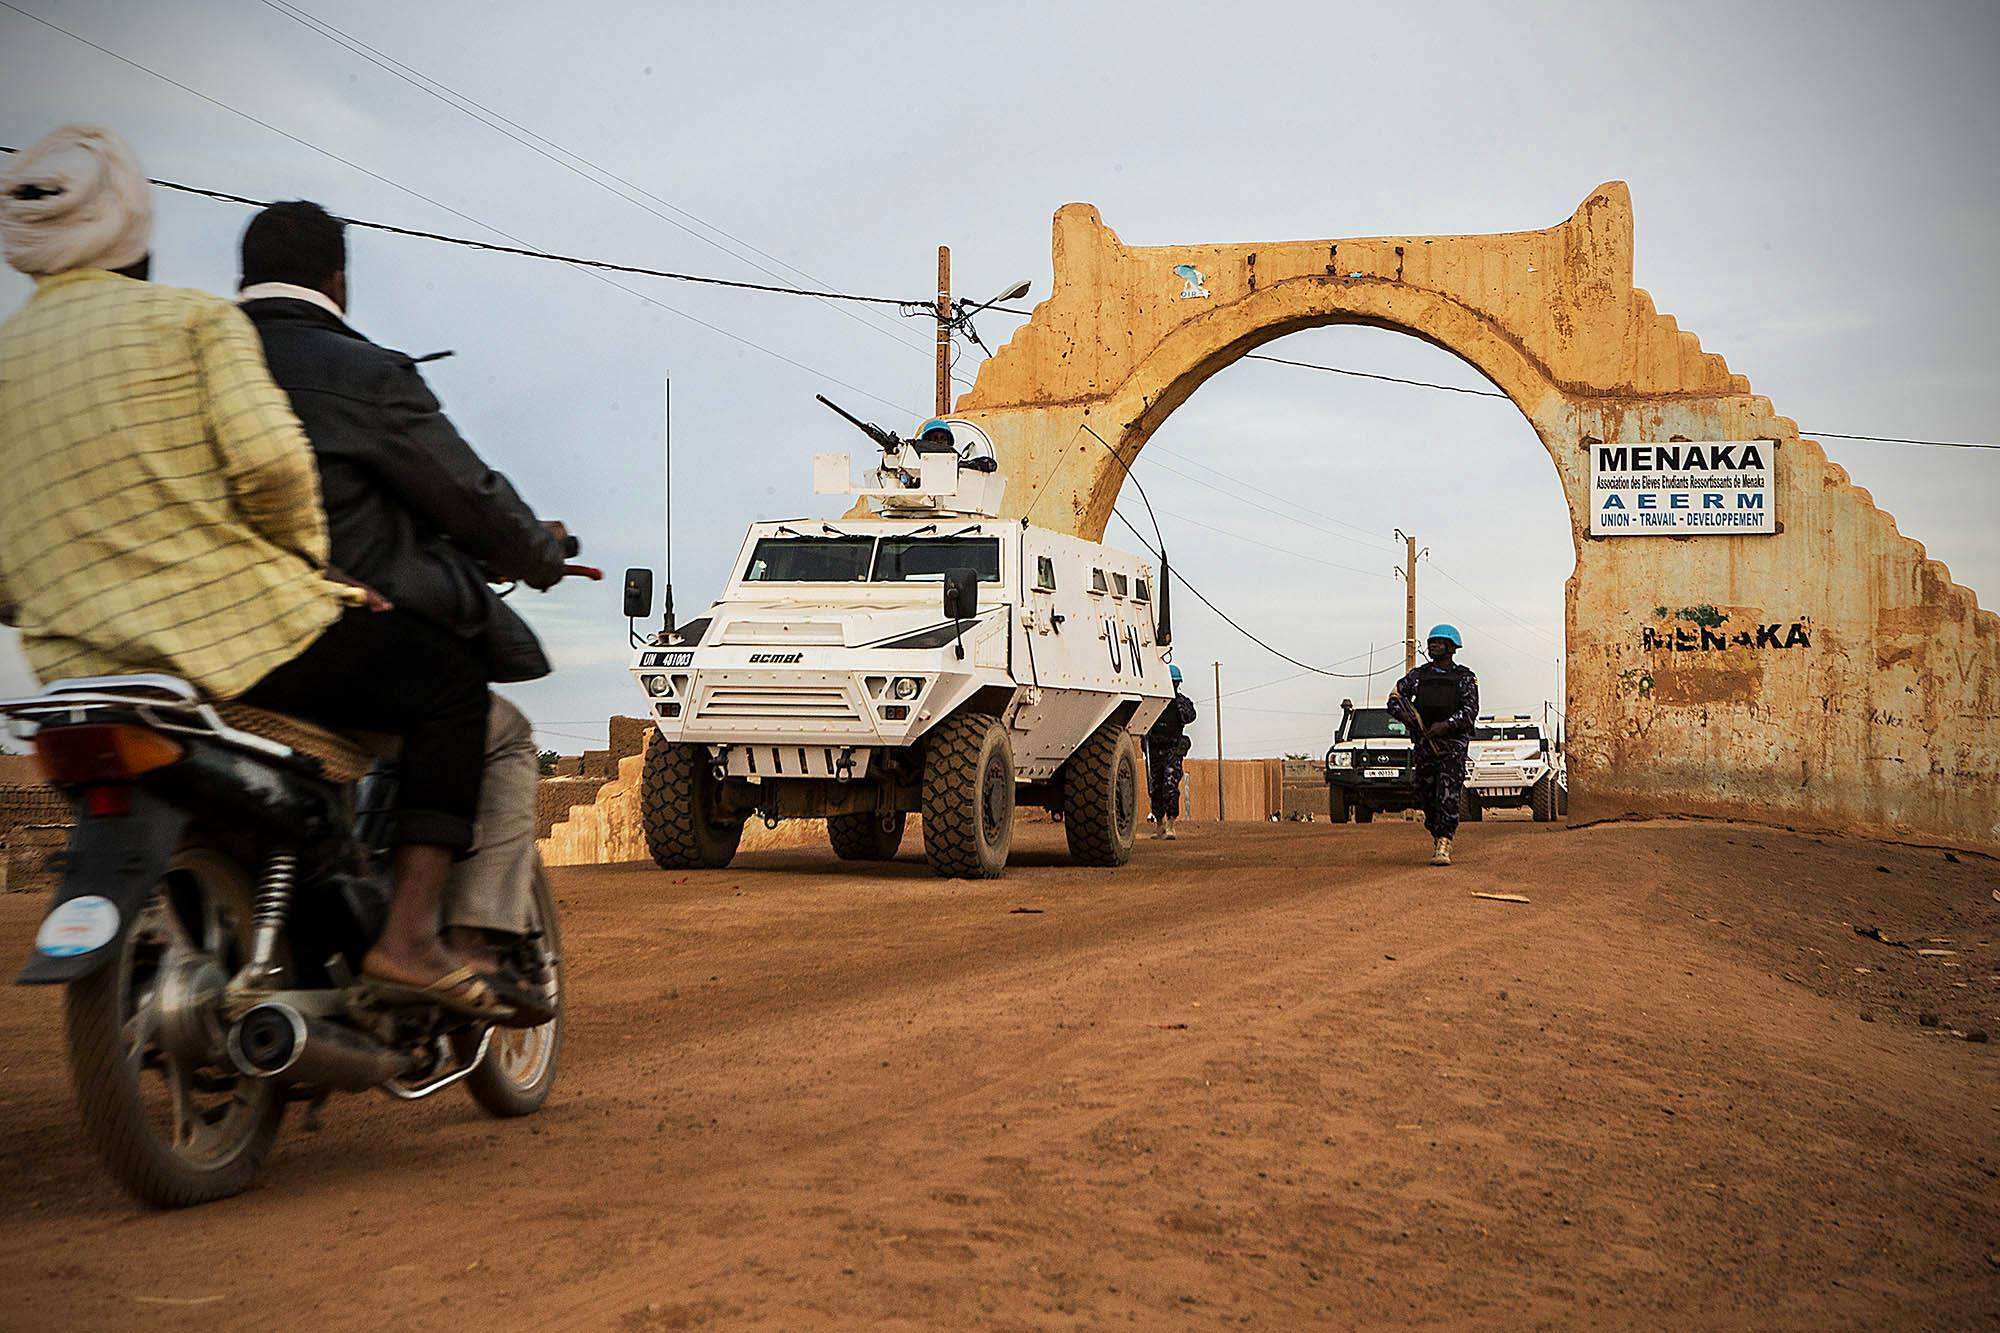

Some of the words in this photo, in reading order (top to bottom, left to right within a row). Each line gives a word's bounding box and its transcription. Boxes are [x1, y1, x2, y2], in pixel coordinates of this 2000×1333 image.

[1600, 446, 1765, 471] MENAKA
[1597, 476, 1629, 490] Association
[1631, 476, 1640, 489] des
[1662, 475, 1689, 489] Etudiants
[1690, 474, 1732, 488] Ressortissants
[1734, 474, 1741, 488] de
[1601, 513, 1629, 527] UNION
[1640, 513, 1677, 526] TRAVAIL
[1687, 513, 1764, 526] DEVELOPPEMENT
[1105, 620, 1143, 678] UN
[643, 653, 657, 666] UN
